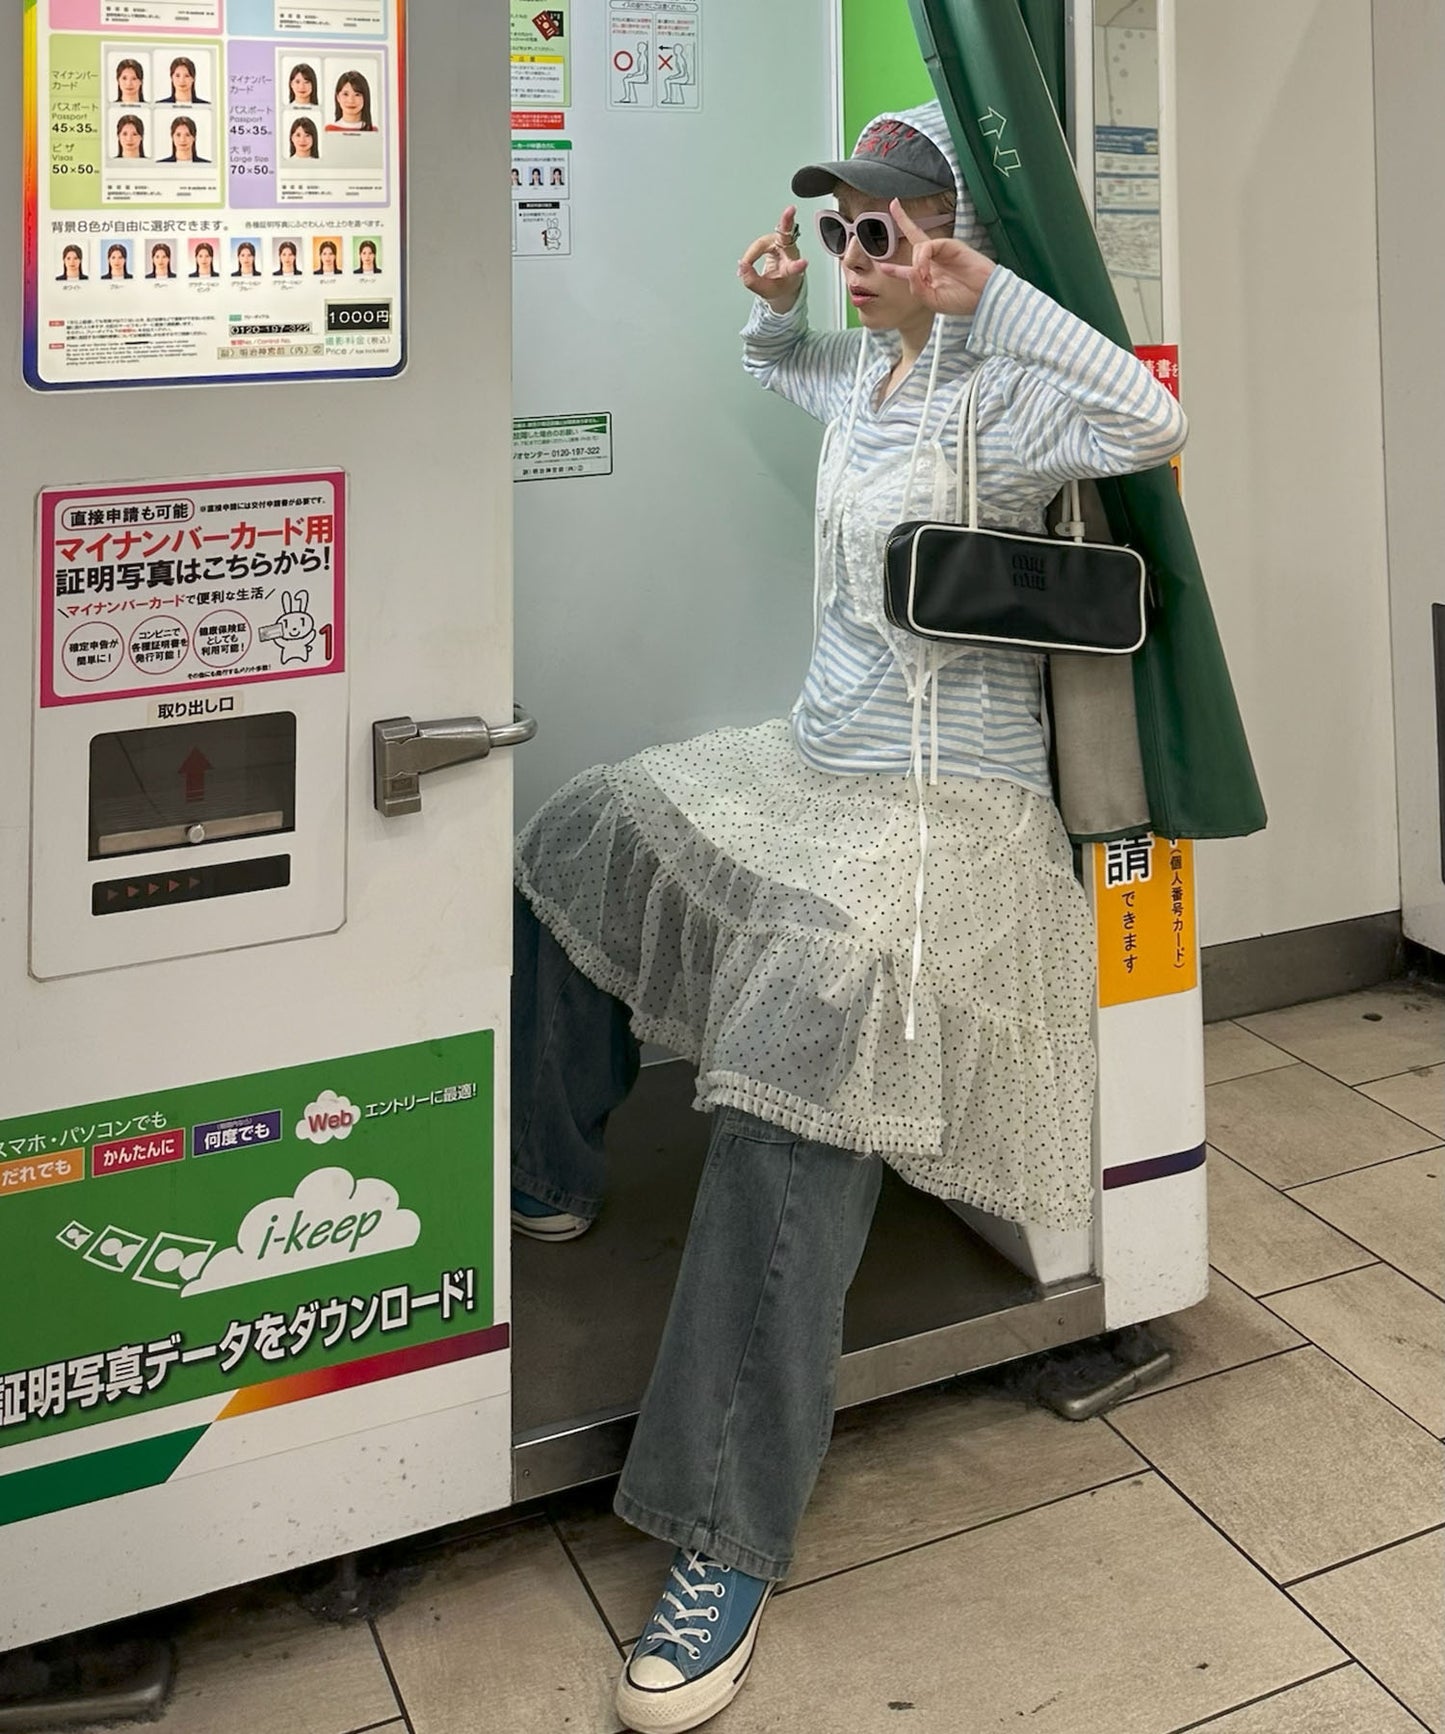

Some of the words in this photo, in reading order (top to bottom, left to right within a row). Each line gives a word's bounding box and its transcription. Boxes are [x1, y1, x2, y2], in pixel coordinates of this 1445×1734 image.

[52, 70, 99, 80] マイナンバー
[230, 75, 273, 85] マイナンバー
[52, 82, 78, 90] カード
[230, 86, 254, 94] カード
[52, 102, 99, 111] パスポート
[230, 105, 273, 115] パスポート
[51, 113, 87, 121] Passport
[230, 115, 262, 123] Passport
[51, 220, 229, 234] 背景8色が自由に選択できます。
[329, 309, 389, 324] 1000円
[70, 503, 189, 528] 直接申請も可能
[56, 515, 334, 564] マイナンバーカード用
[56, 546, 330, 598] 証明写真はこちらから!
[139, 627, 181, 640] コンビニで
[199, 623, 247, 637] 健康保険証
[69, 638, 120, 653] 確定申告が
[131, 637, 189, 653] 各種証明書を
[207, 633, 239, 645] としても
[135, 649, 181, 663] 発行可能!
[201, 643, 246, 657] 利用可能!
[76, 653, 112, 667] 簡単に!
[157, 696, 235, 720] 取り出し口
[1121, 891, 1138, 974] できます
[365, 1082, 478, 1119] エントリーに最適!
[308, 1109, 354, 1134] Web
[204, 1121, 271, 1150] 何度でも
[103, 1138, 176, 1168] かんたんに
[1, 1159, 72, 1187] だれでも
[257, 1208, 382, 1260] i-keep
[0, 1267, 476, 1428] 証明写真データをダウンロード!
